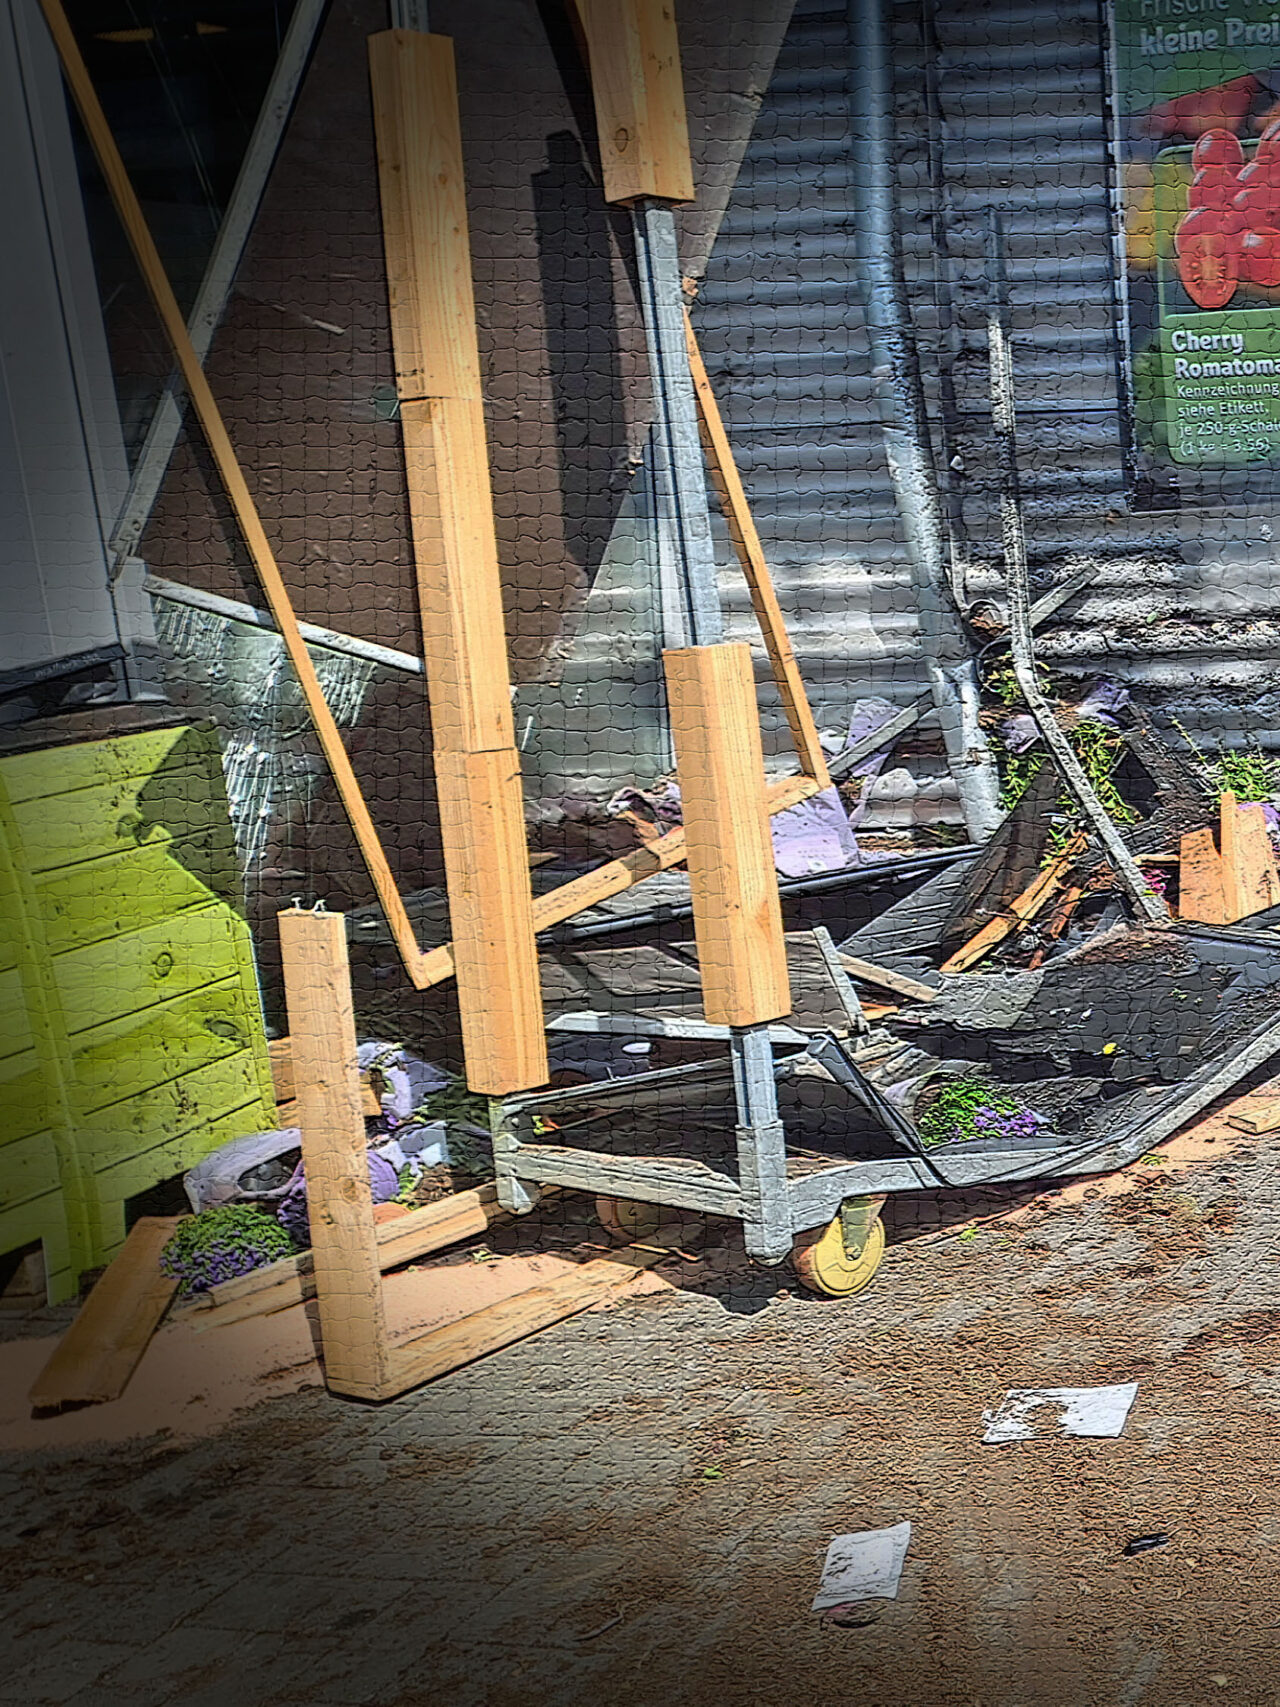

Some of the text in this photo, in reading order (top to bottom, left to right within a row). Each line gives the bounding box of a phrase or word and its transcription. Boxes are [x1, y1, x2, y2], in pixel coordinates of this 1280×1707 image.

[1140, 24, 1219, 56] kleine
[1171, 330, 1244, 354] Cherry
[1177, 403, 1215, 417] siehe
[1179, 422, 1193, 438] je
